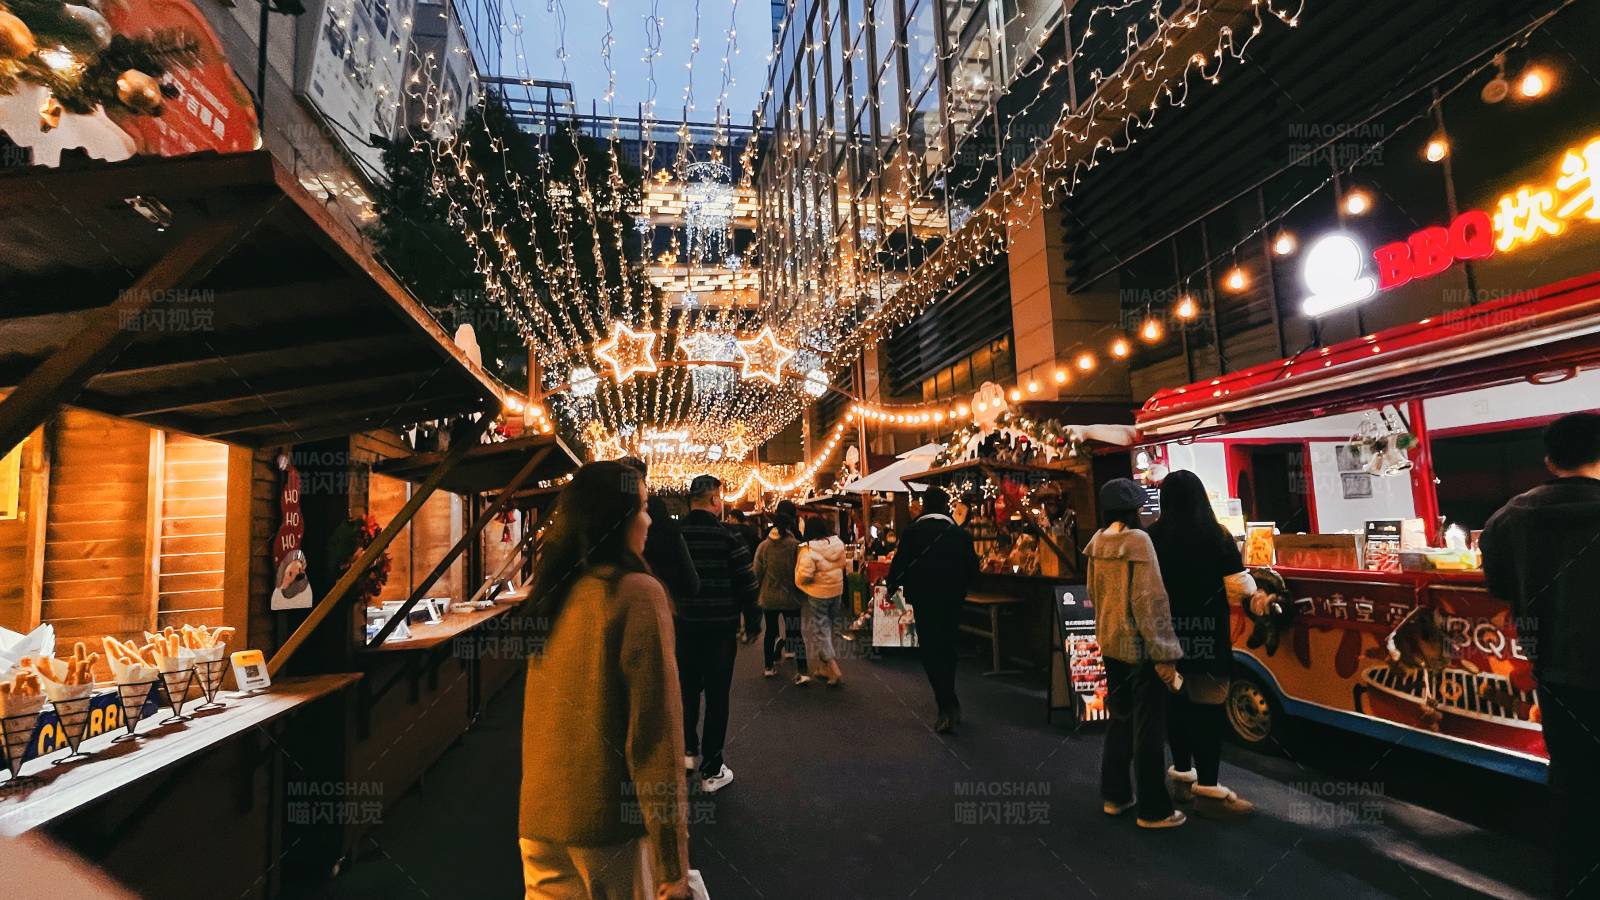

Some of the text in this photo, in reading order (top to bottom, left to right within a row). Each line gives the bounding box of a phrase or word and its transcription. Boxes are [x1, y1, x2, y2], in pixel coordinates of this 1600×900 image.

[1373, 209, 1495, 291] BBQ
[284, 489, 299, 504] HO
[285, 511, 300, 527] HO
[281, 534, 296, 551] HO
